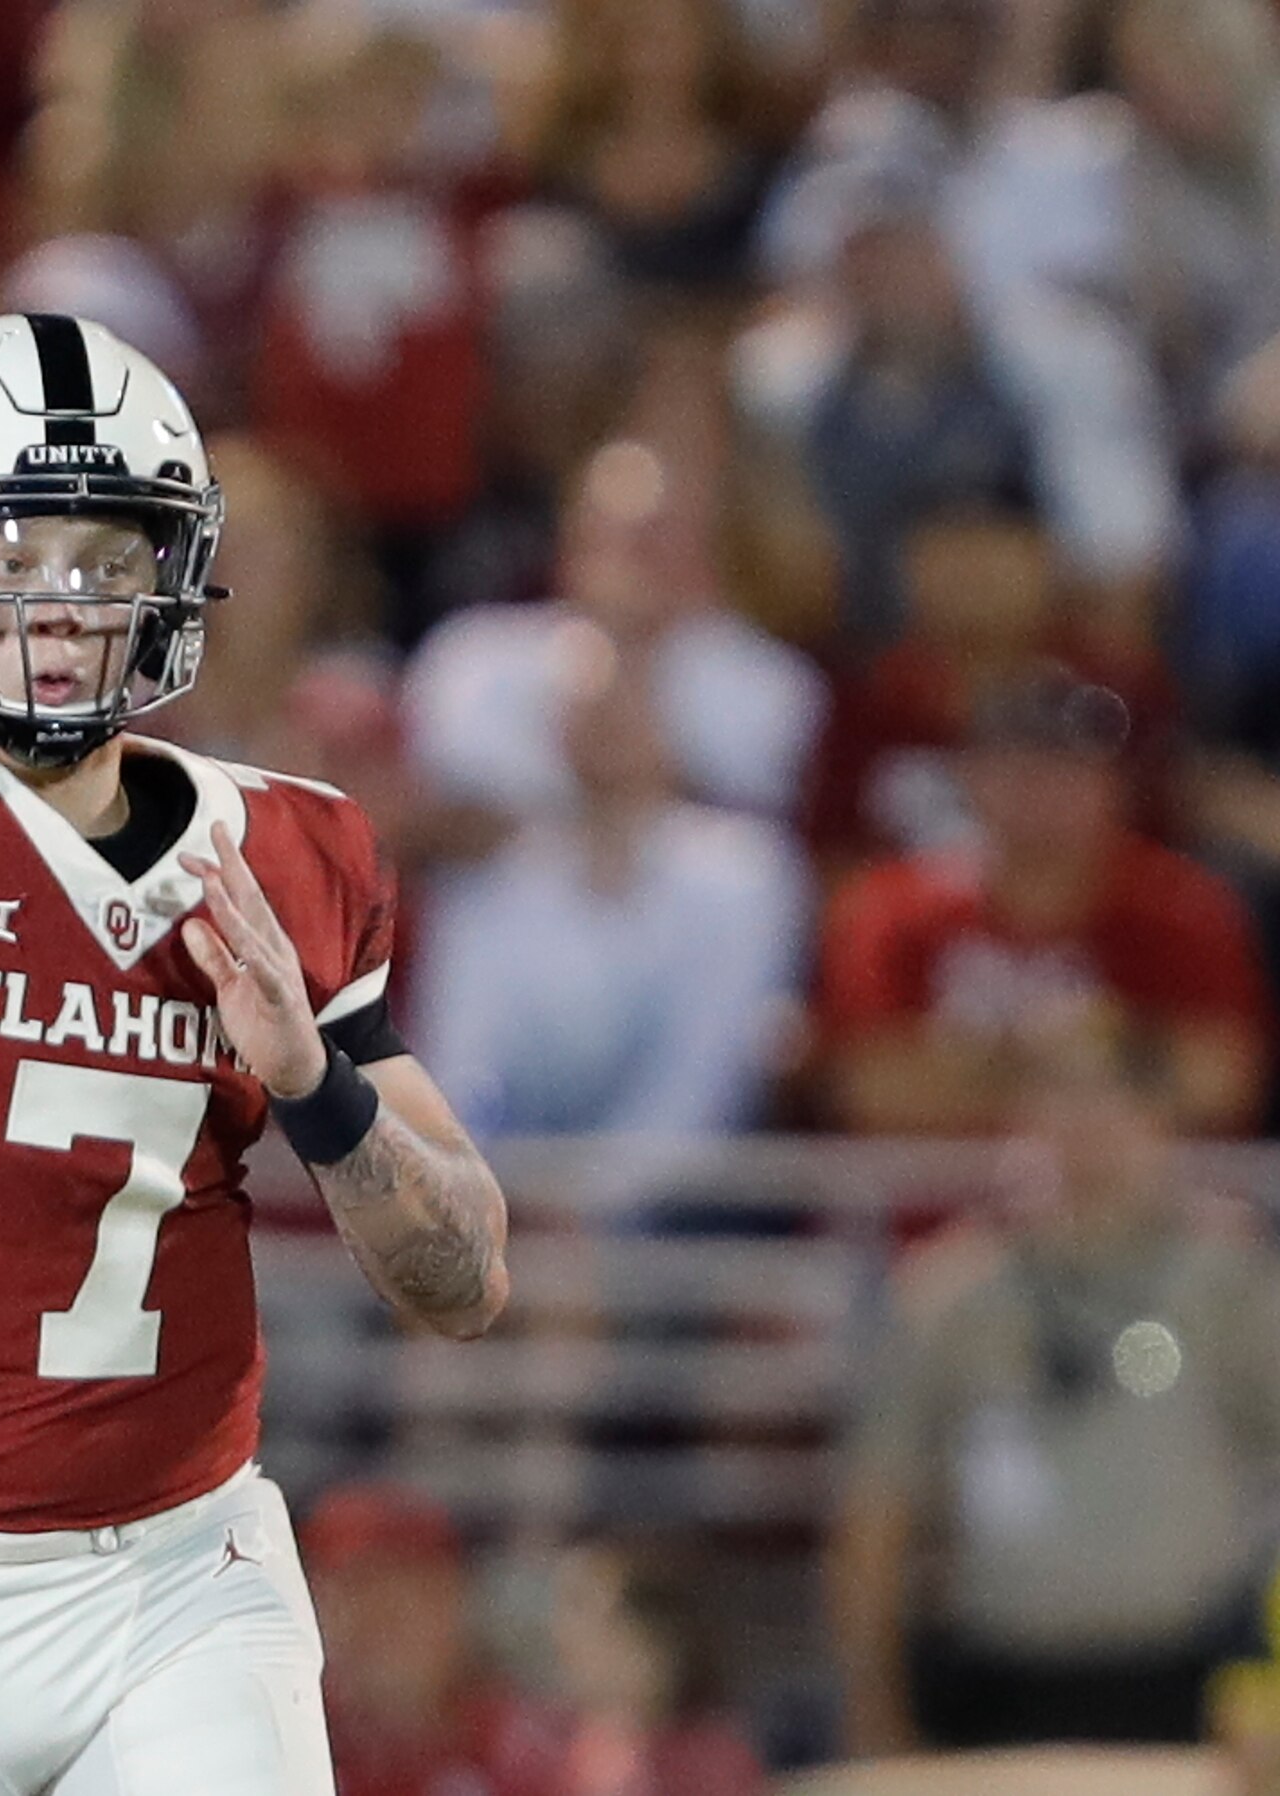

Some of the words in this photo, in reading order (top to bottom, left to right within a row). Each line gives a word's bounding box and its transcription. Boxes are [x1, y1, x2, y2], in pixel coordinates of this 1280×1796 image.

[27, 445, 118, 465] UNITY
[107, 900, 140, 951] OU
[5, 1058, 212, 1378] 7
